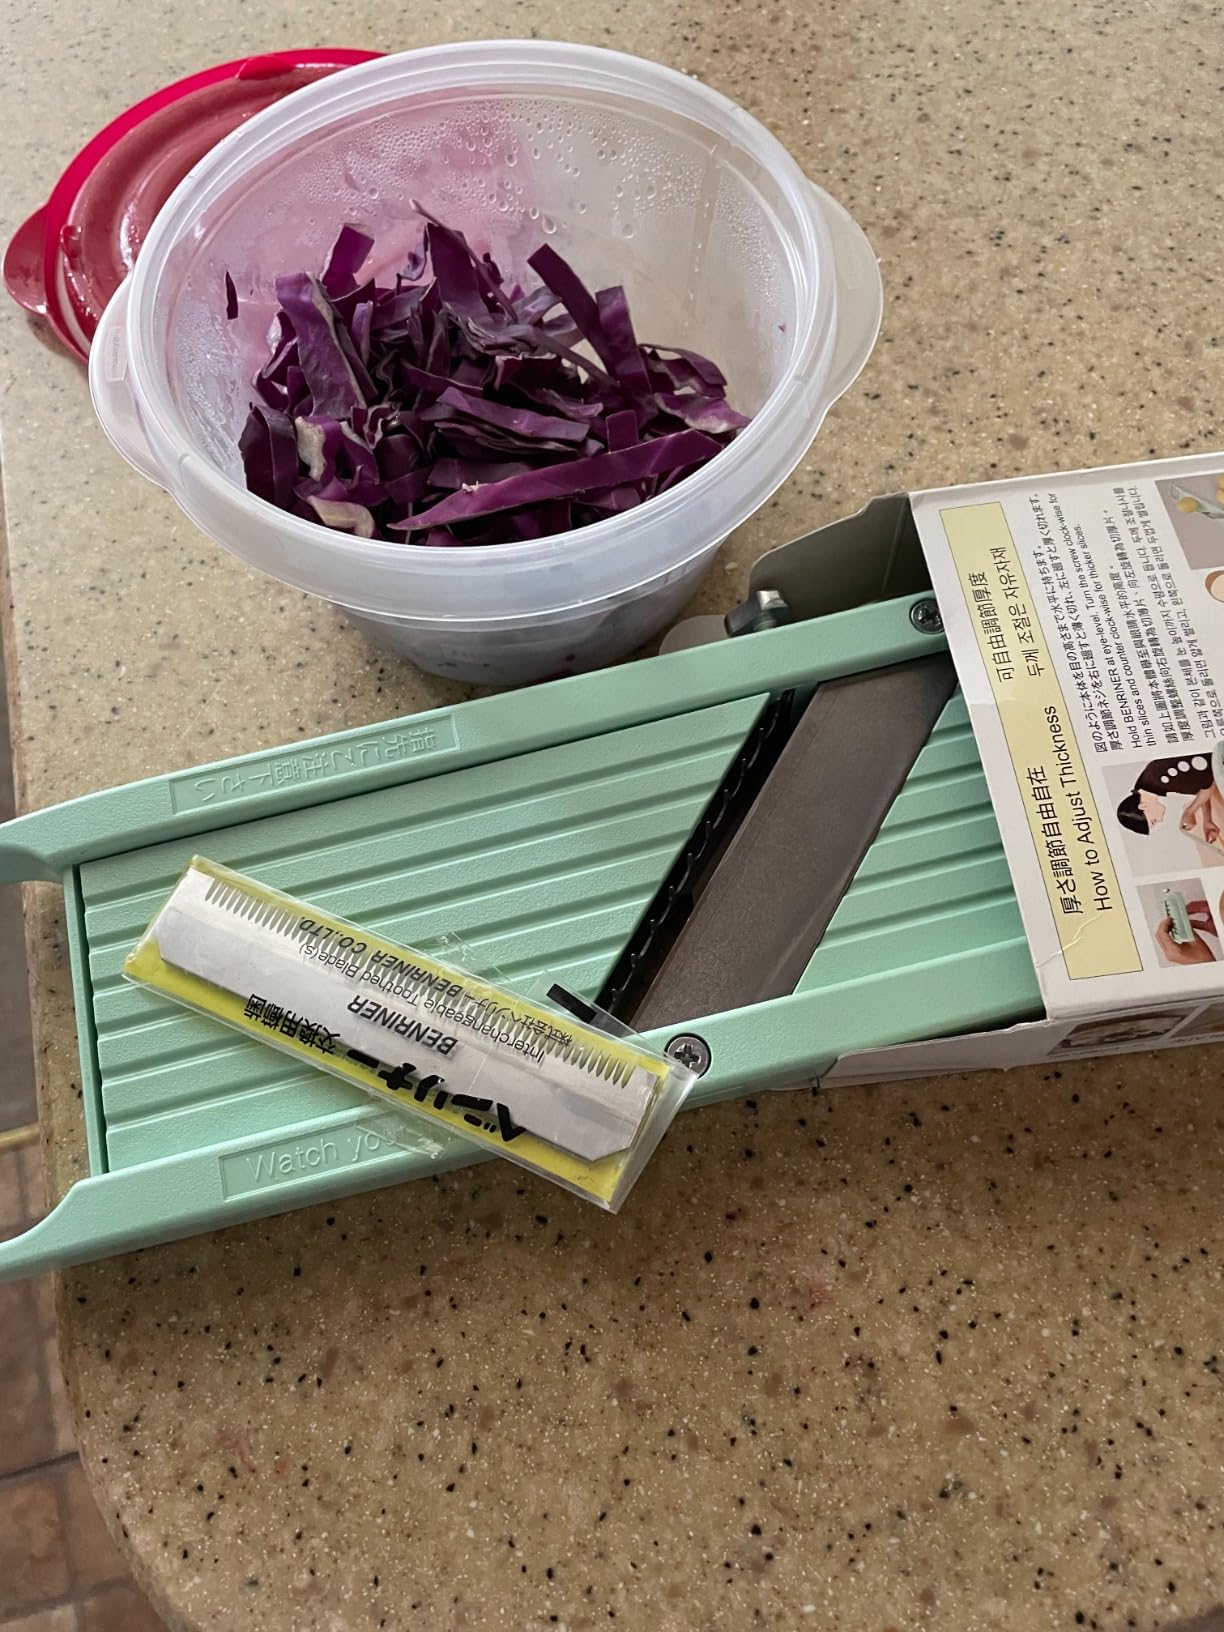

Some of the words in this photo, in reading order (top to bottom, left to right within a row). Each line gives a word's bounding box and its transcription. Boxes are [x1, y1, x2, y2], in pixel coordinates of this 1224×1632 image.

[1048, 493, 1057, 503] for
[1053, 505, 1073, 546] clock-wise
[1074, 524, 1087, 548] slices.
[989, 547, 1019, 599] 자유자재
[1068, 548, 1082, 572] screw
[1083, 551, 1098, 578] thicker
[1078, 574, 1088, 587] the
[1083, 590, 1095, 609] Turn
[1093, 581, 1103, 591] for
[968, 572, 1014, 682] 可自由調節厚度
[1008, 603, 1034, 643] 조절은
[1090, 612, 1112, 654] eye-level.
[1098, 594, 1119, 639] clock-wise
[1104, 656, 1115, 665] at
[1114, 642, 1132, 675] counter
[1108, 668, 1133, 722] BENRINER
[1125, 678, 1139, 695] and
[1134, 698, 1149, 725] slices
[1044, 706, 1076, 787] Thickness
[1126, 725, 1142, 747] Hold
[1143, 728, 1156, 746] thin
[1065, 791, 1094, 843] Adjust
[1026, 766, 1083, 913] 厚さ調節自由自在
[1084, 849, 1099, 865] to
[1090, 871, 1112, 910] How
[296, 940, 360, 978] Blade(s)
[369, 948, 463, 999] BENRINER
[358, 969, 420, 1006] Toothed
[345, 992, 458, 1057] BENRINER
[420, 996, 546, 1064] Interchangeable
[345, 1048, 527, 1143] ベンリナー
[247, 1137, 338, 1184] Watch
